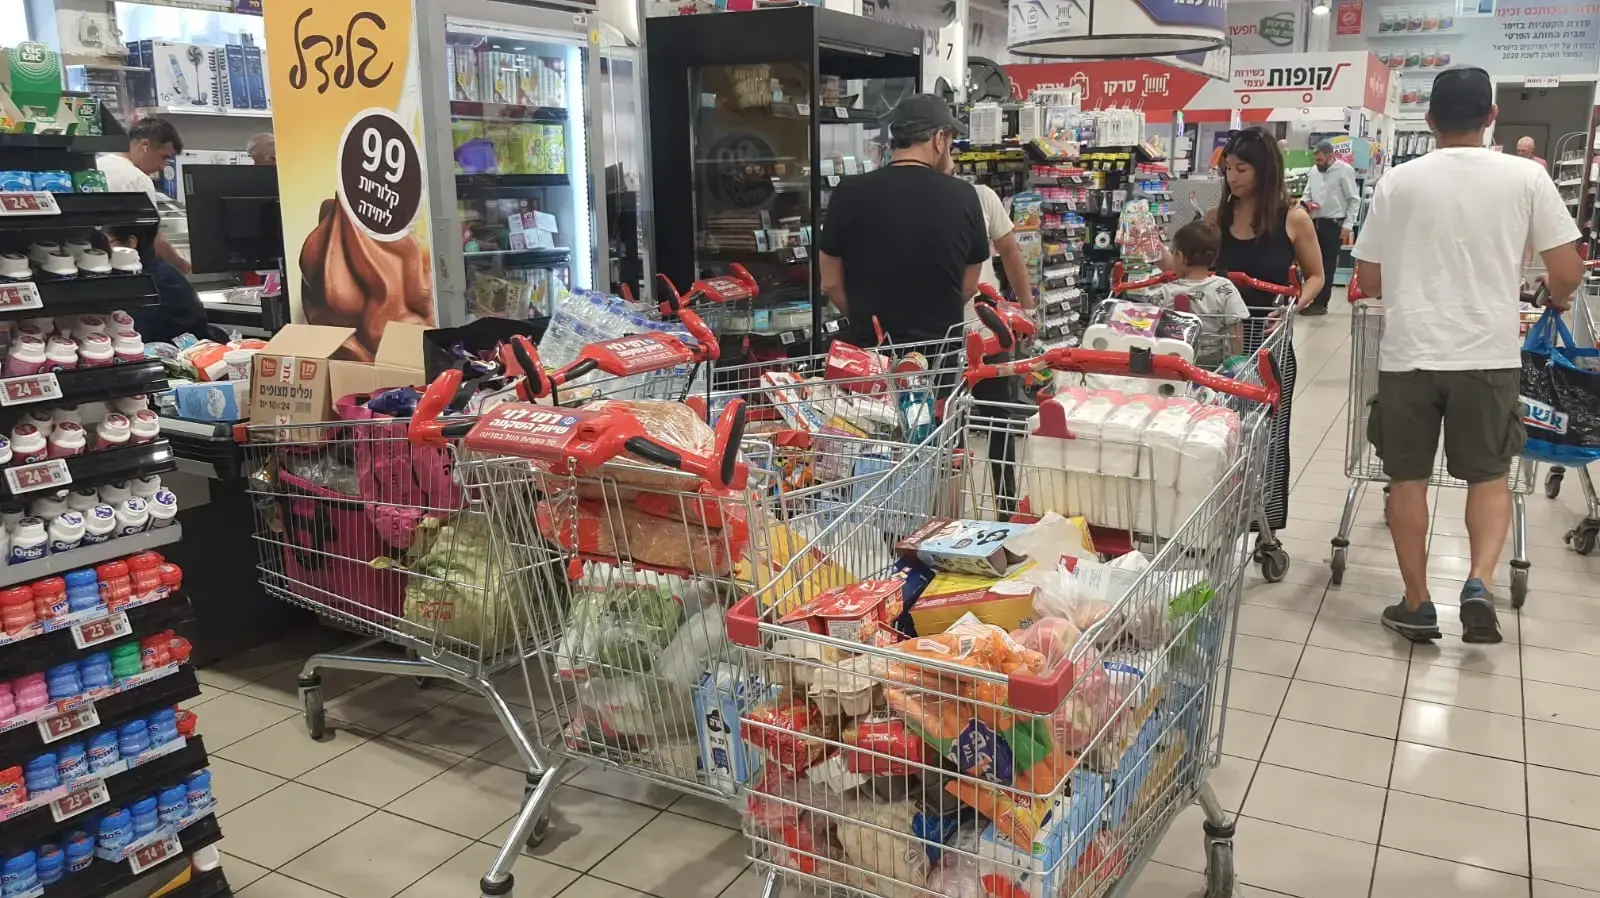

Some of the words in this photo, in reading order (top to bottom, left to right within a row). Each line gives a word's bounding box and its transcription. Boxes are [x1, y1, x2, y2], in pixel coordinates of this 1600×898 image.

[946, 43, 953, 60] 7
[1234, 69, 1265, 78] בשירות
[1267, 67, 1333, 91] קופות
[1104, 80, 1136, 96] סרקו
[1243, 79, 1265, 88] עצמי
[361, 127, 407, 184] 99
[357, 174, 400, 210] קלוריות
[12, 196, 29, 209] 24
[357, 199, 393, 227] ליחידה
[15, 382, 32, 397] 24
[259, 384, 288, 398] מצופים
[290, 383, 313, 401] ופלים
[501, 408, 531, 420] לוי
[528, 411, 563, 424] רמי
[488, 418, 532, 430] השקמה
[531, 422, 570, 435] שיווק
[25, 470, 42, 485] 24
[91, 623, 105, 638] 23
[56, 716, 72, 732] 23
[67, 794, 83, 811] 23
[144, 846, 159, 862] 14
